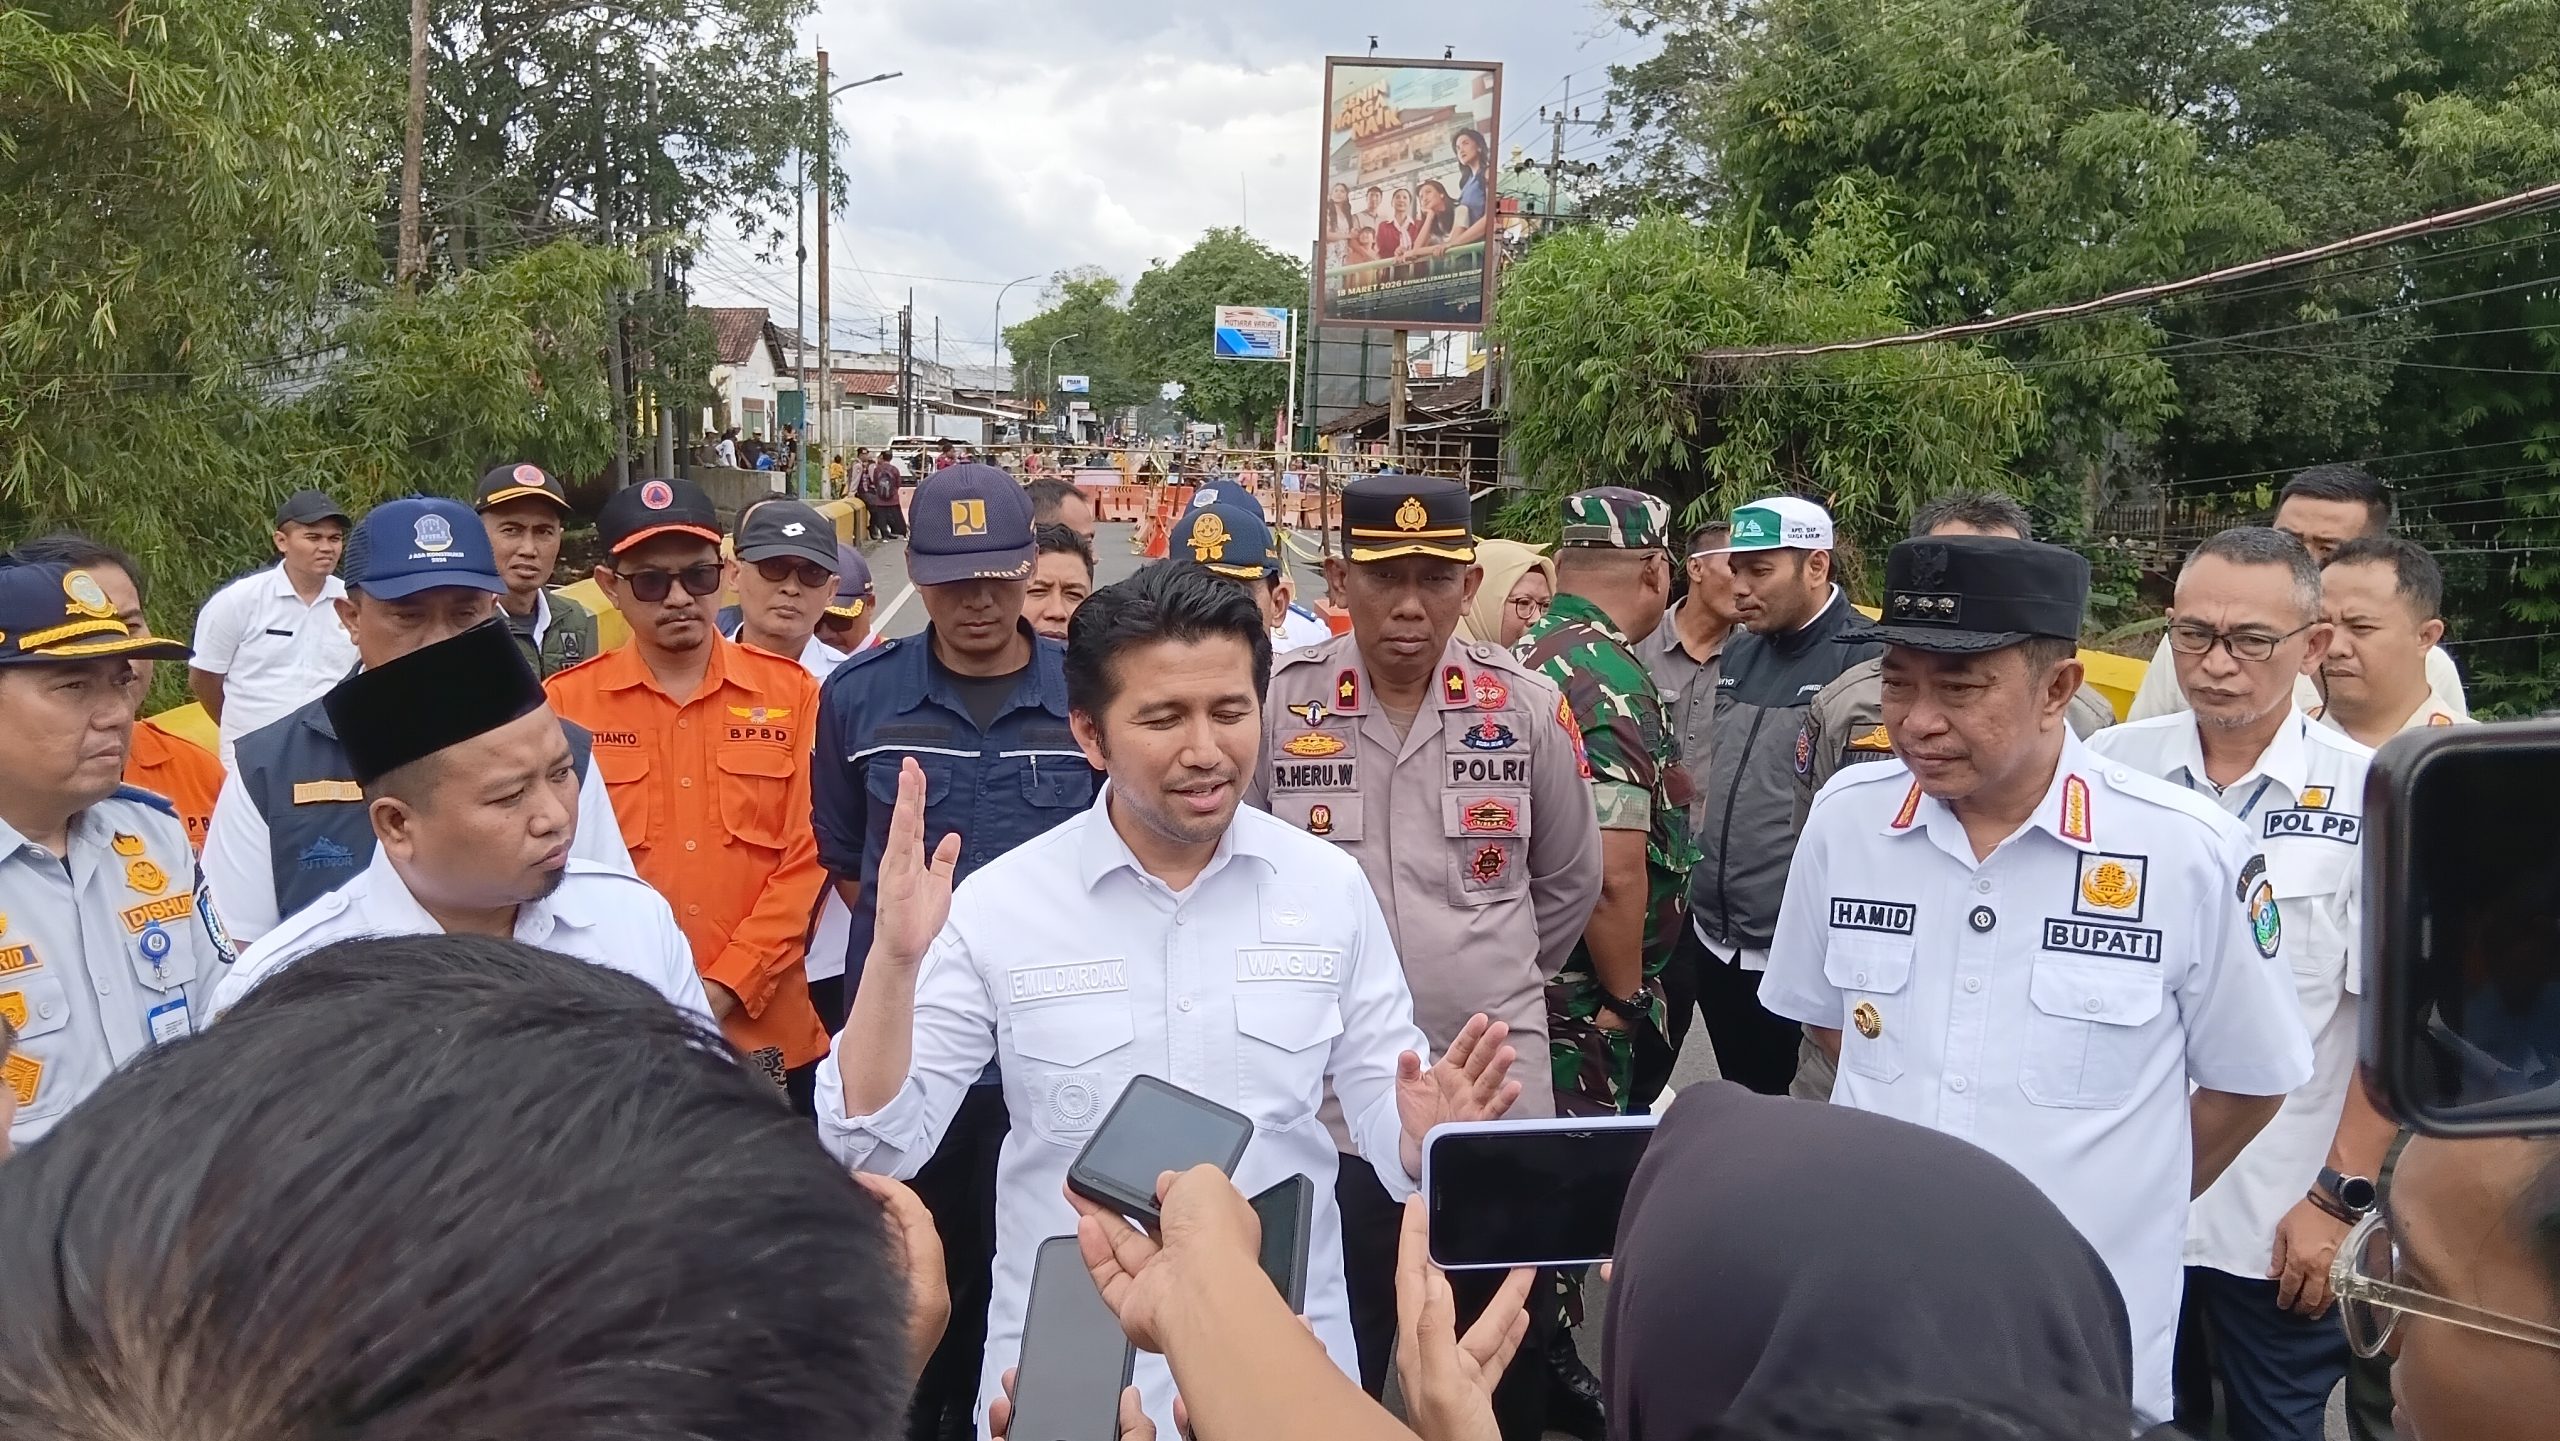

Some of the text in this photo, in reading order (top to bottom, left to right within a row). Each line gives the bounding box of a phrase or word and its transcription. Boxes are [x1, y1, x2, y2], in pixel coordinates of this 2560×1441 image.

[1352, 106, 1401, 138] NAIK
[1337, 289, 1346, 297] 18
[1348, 284, 1378, 295] MARET
[1380, 280, 1402, 291] 2026
[1225, 319, 1252, 327] MUTIARA
[593, 732, 637, 745] TIANTO
[730, 728, 787, 742] BPBD
[1276, 764, 1353, 787] R.HERU.W
[1453, 759, 1525, 781] POLRI
[2270, 814, 2355, 837] POL PP
[1838, 904, 1908, 929] HAMID
[2051, 924, 2154, 959] BUPATI
[0, 949, 25, 971] RID
[1246, 952, 1335, 978] WAGUB
[1012, 962, 1124, 998] EMIL DARDAK
